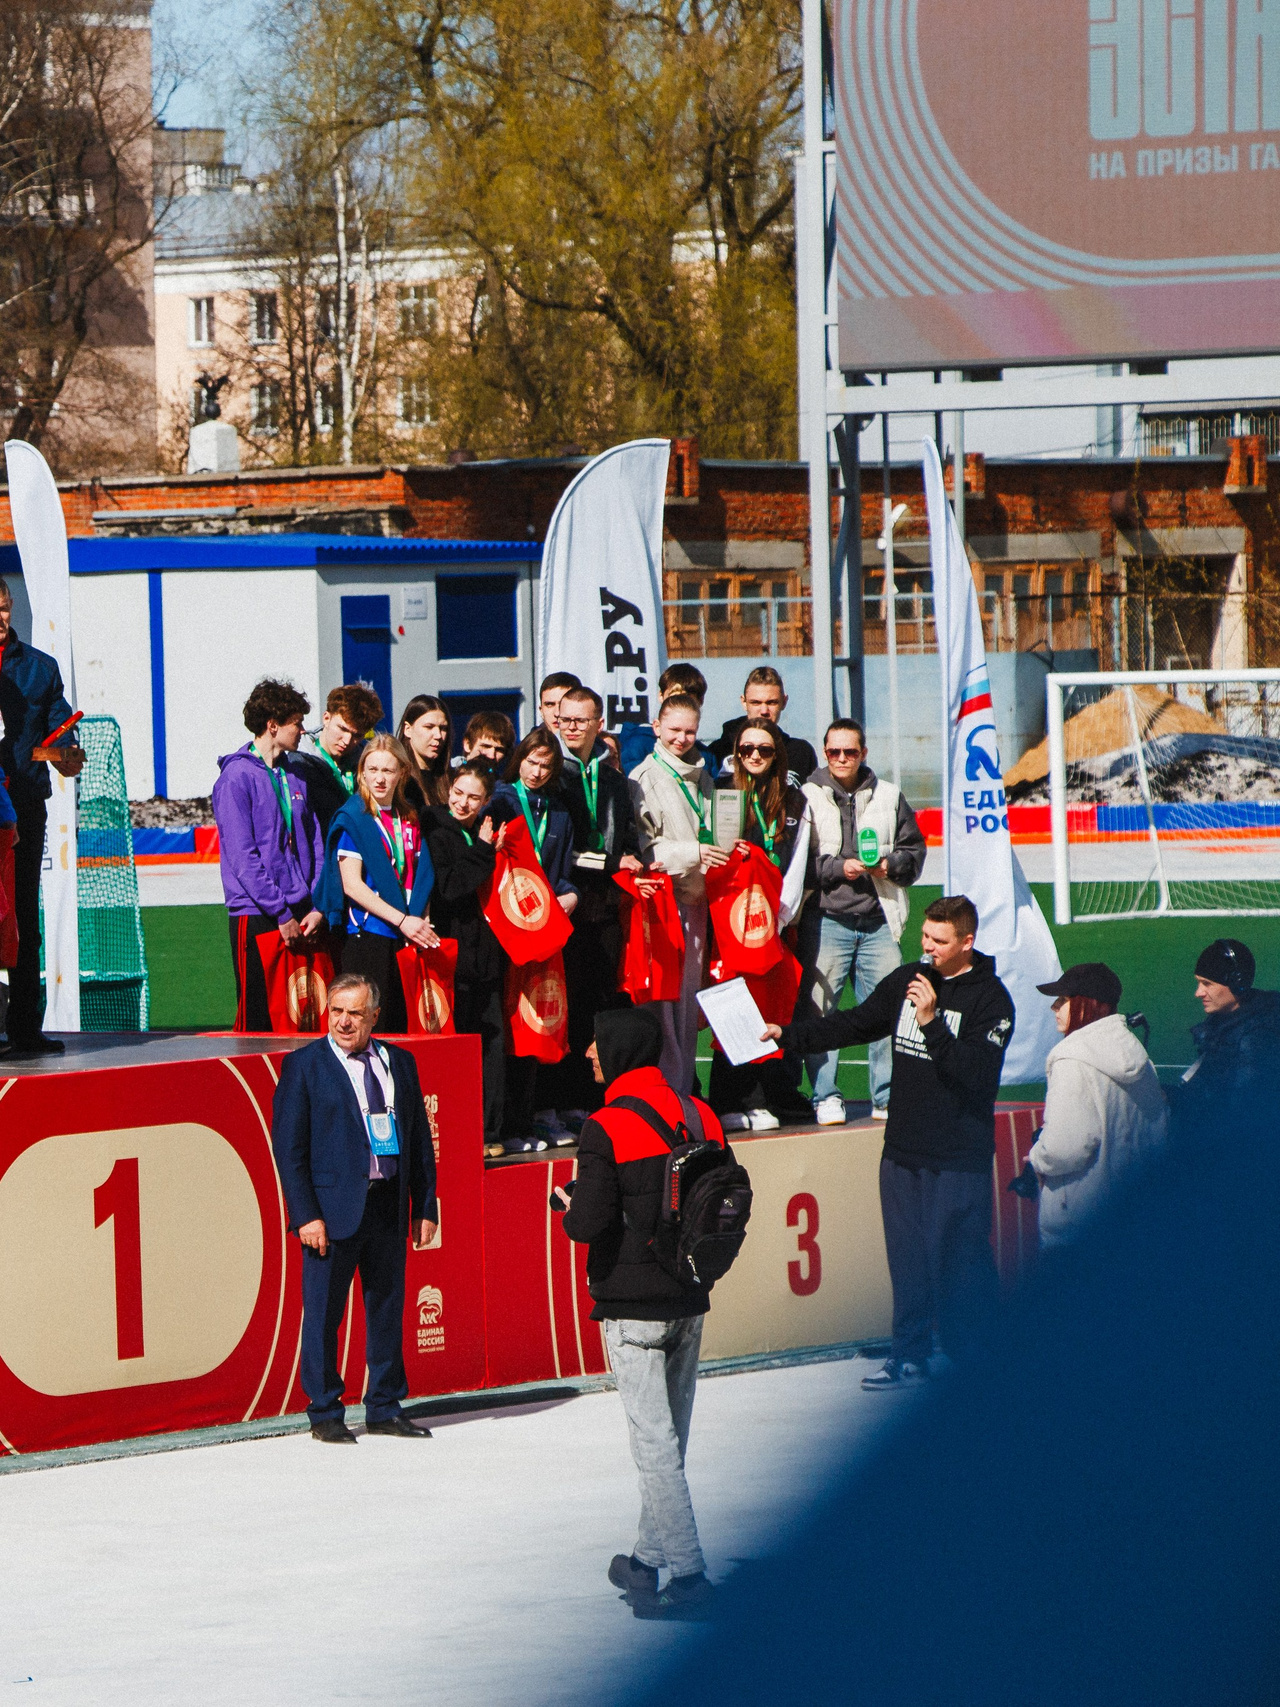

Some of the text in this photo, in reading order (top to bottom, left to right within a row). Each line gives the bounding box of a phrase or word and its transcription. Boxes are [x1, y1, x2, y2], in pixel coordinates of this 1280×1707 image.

[1088, 0, 1280, 141] ЭСТА
[1089, 142, 1280, 181] НА ПРИЗЫ ГА
[599, 586, 650, 731] Е.РУ
[963, 789, 1007, 811] ЕДИ
[965, 814, 1010, 834] РОС
[93, 1157, 145, 1361] 1
[786, 1192, 822, 1297] 3
[417, 1326, 445, 1338] ЕДИНАЯ
[417, 1335, 445, 1347] РОССИЯ
